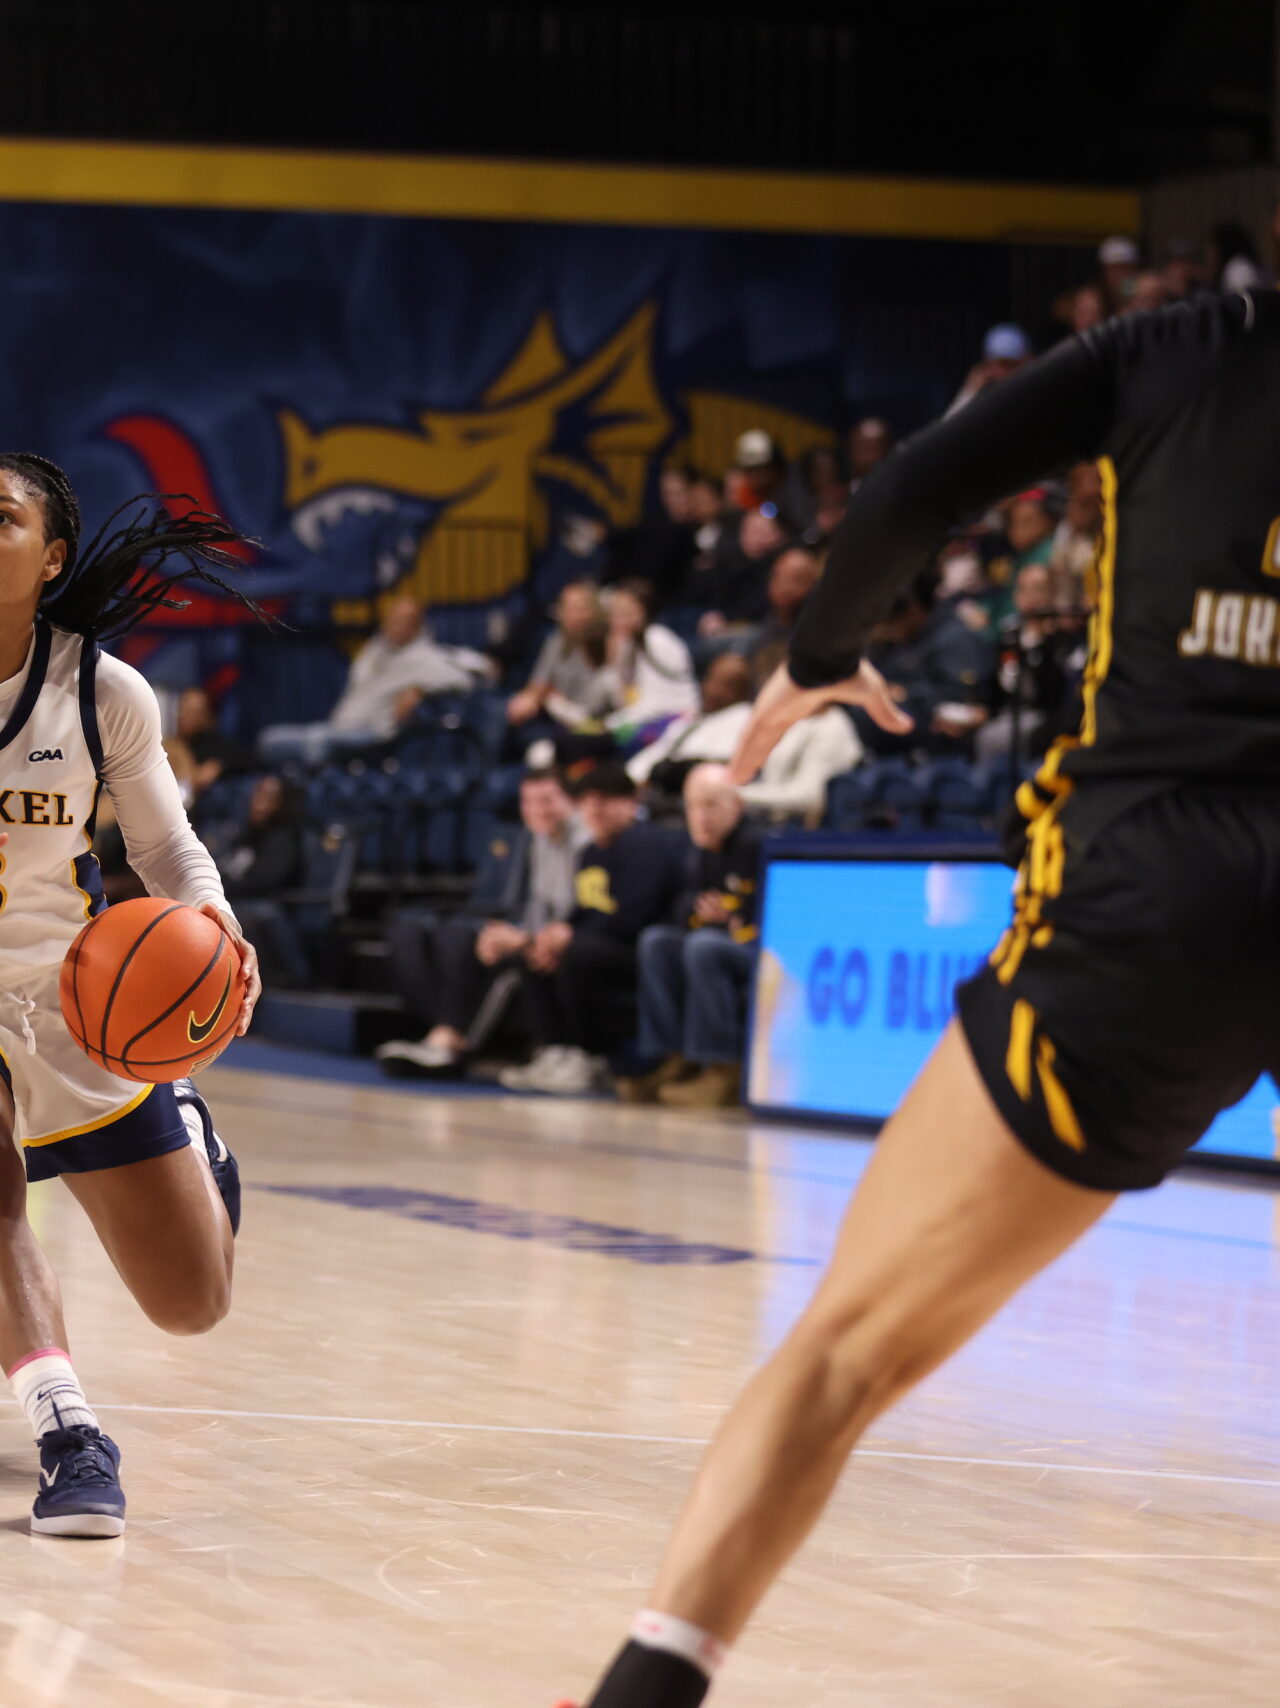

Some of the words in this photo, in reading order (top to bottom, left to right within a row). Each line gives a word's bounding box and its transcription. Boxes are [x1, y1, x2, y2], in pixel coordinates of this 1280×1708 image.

[1177, 587, 1280, 669] JOH
[28, 748, 64, 763] CAA
[807, 946, 870, 1026] GO
[885, 949, 990, 1029] BLU
